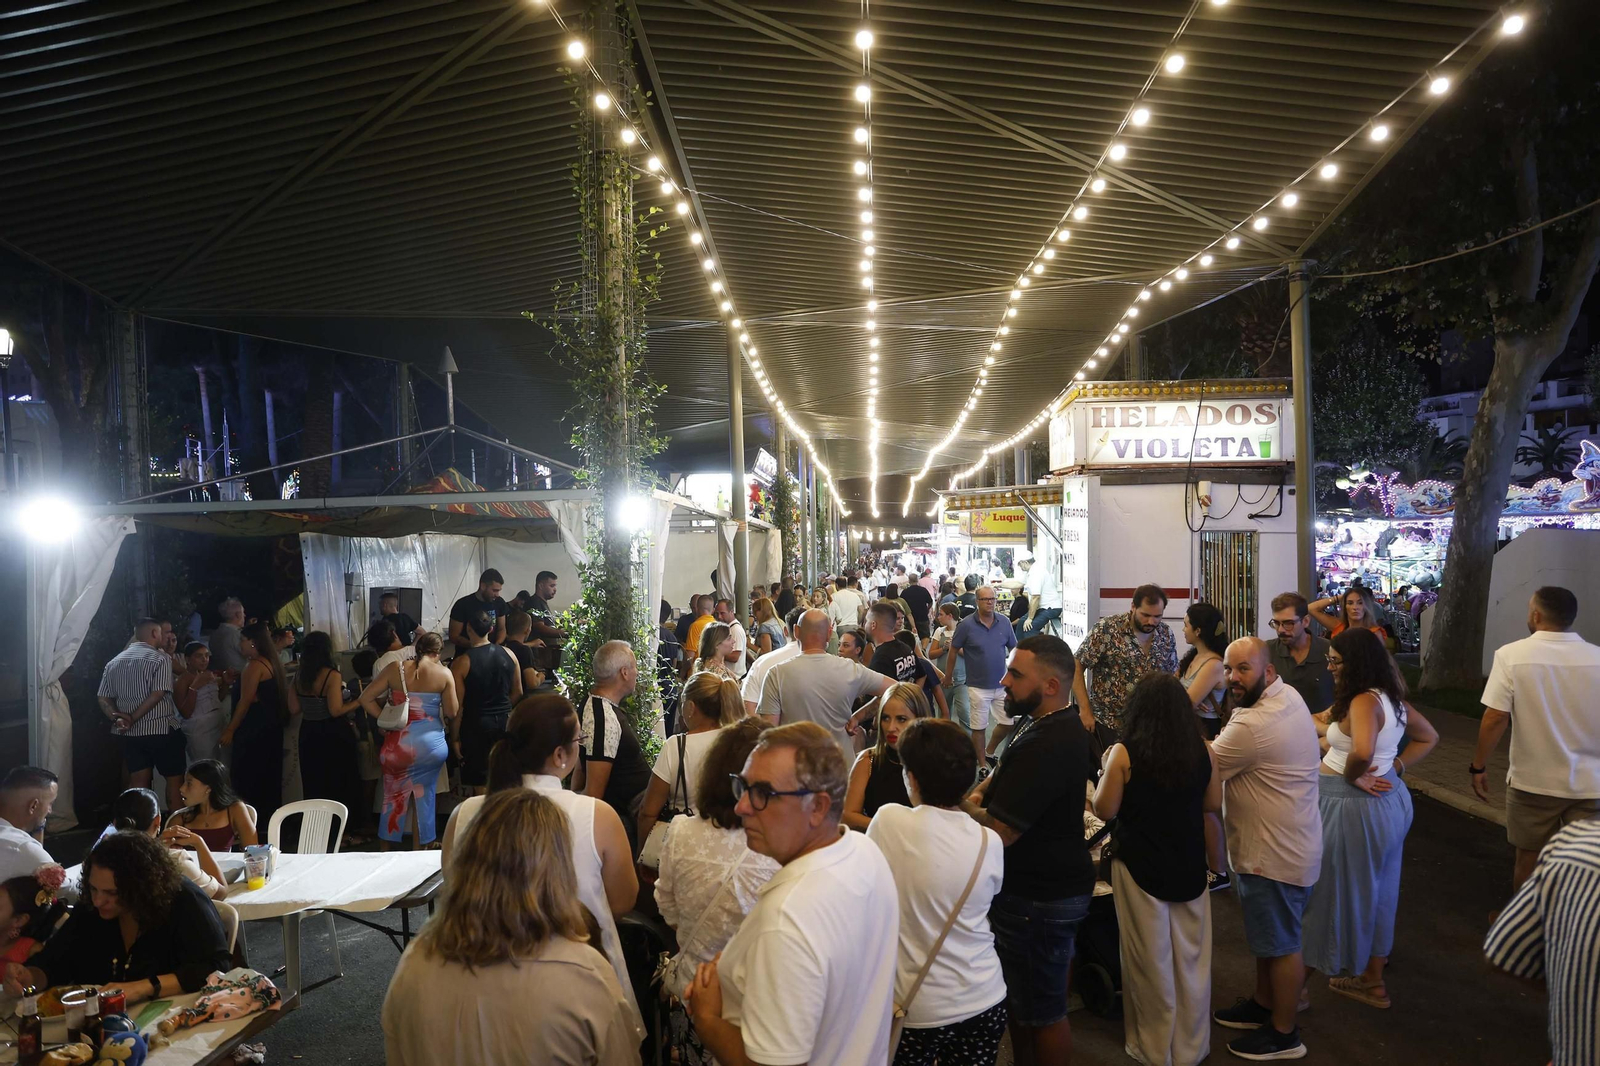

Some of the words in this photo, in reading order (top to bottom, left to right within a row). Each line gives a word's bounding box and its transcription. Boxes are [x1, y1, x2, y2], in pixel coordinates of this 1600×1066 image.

[1091, 403, 1277, 428] HELADOS
[1111, 436, 1258, 458] VIOLETA
[992, 513, 1025, 523] Luque
